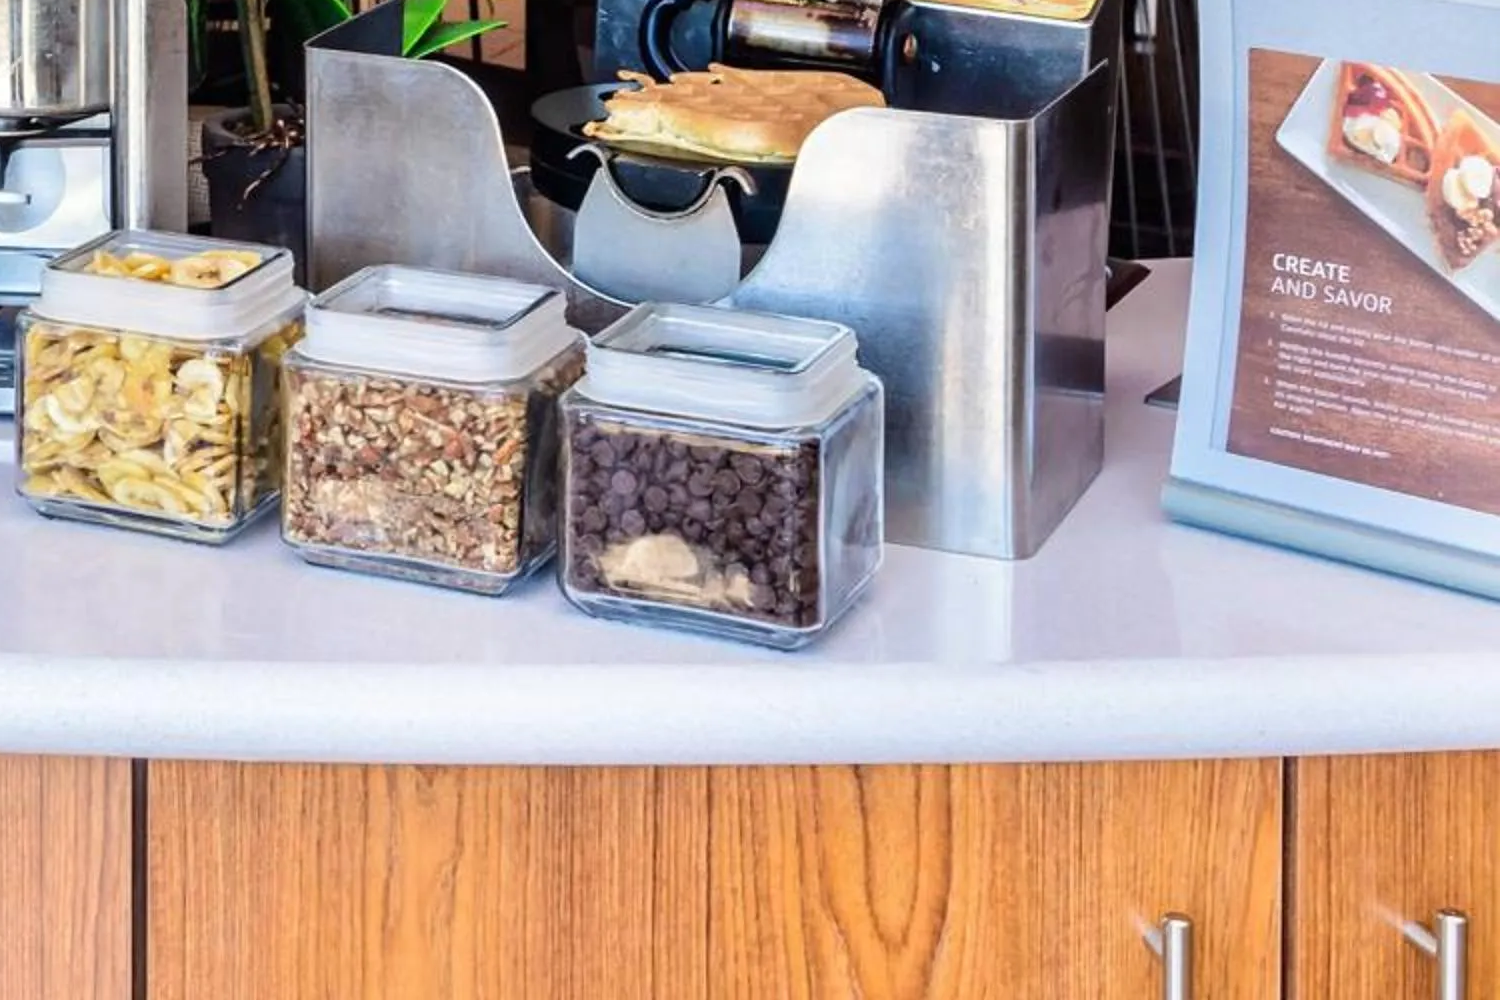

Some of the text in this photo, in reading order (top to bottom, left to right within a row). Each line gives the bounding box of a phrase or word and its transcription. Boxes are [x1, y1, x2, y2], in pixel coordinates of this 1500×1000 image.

[1272, 252, 1352, 284] CREATE
[1270, 276, 1393, 316] AND SAVOR
